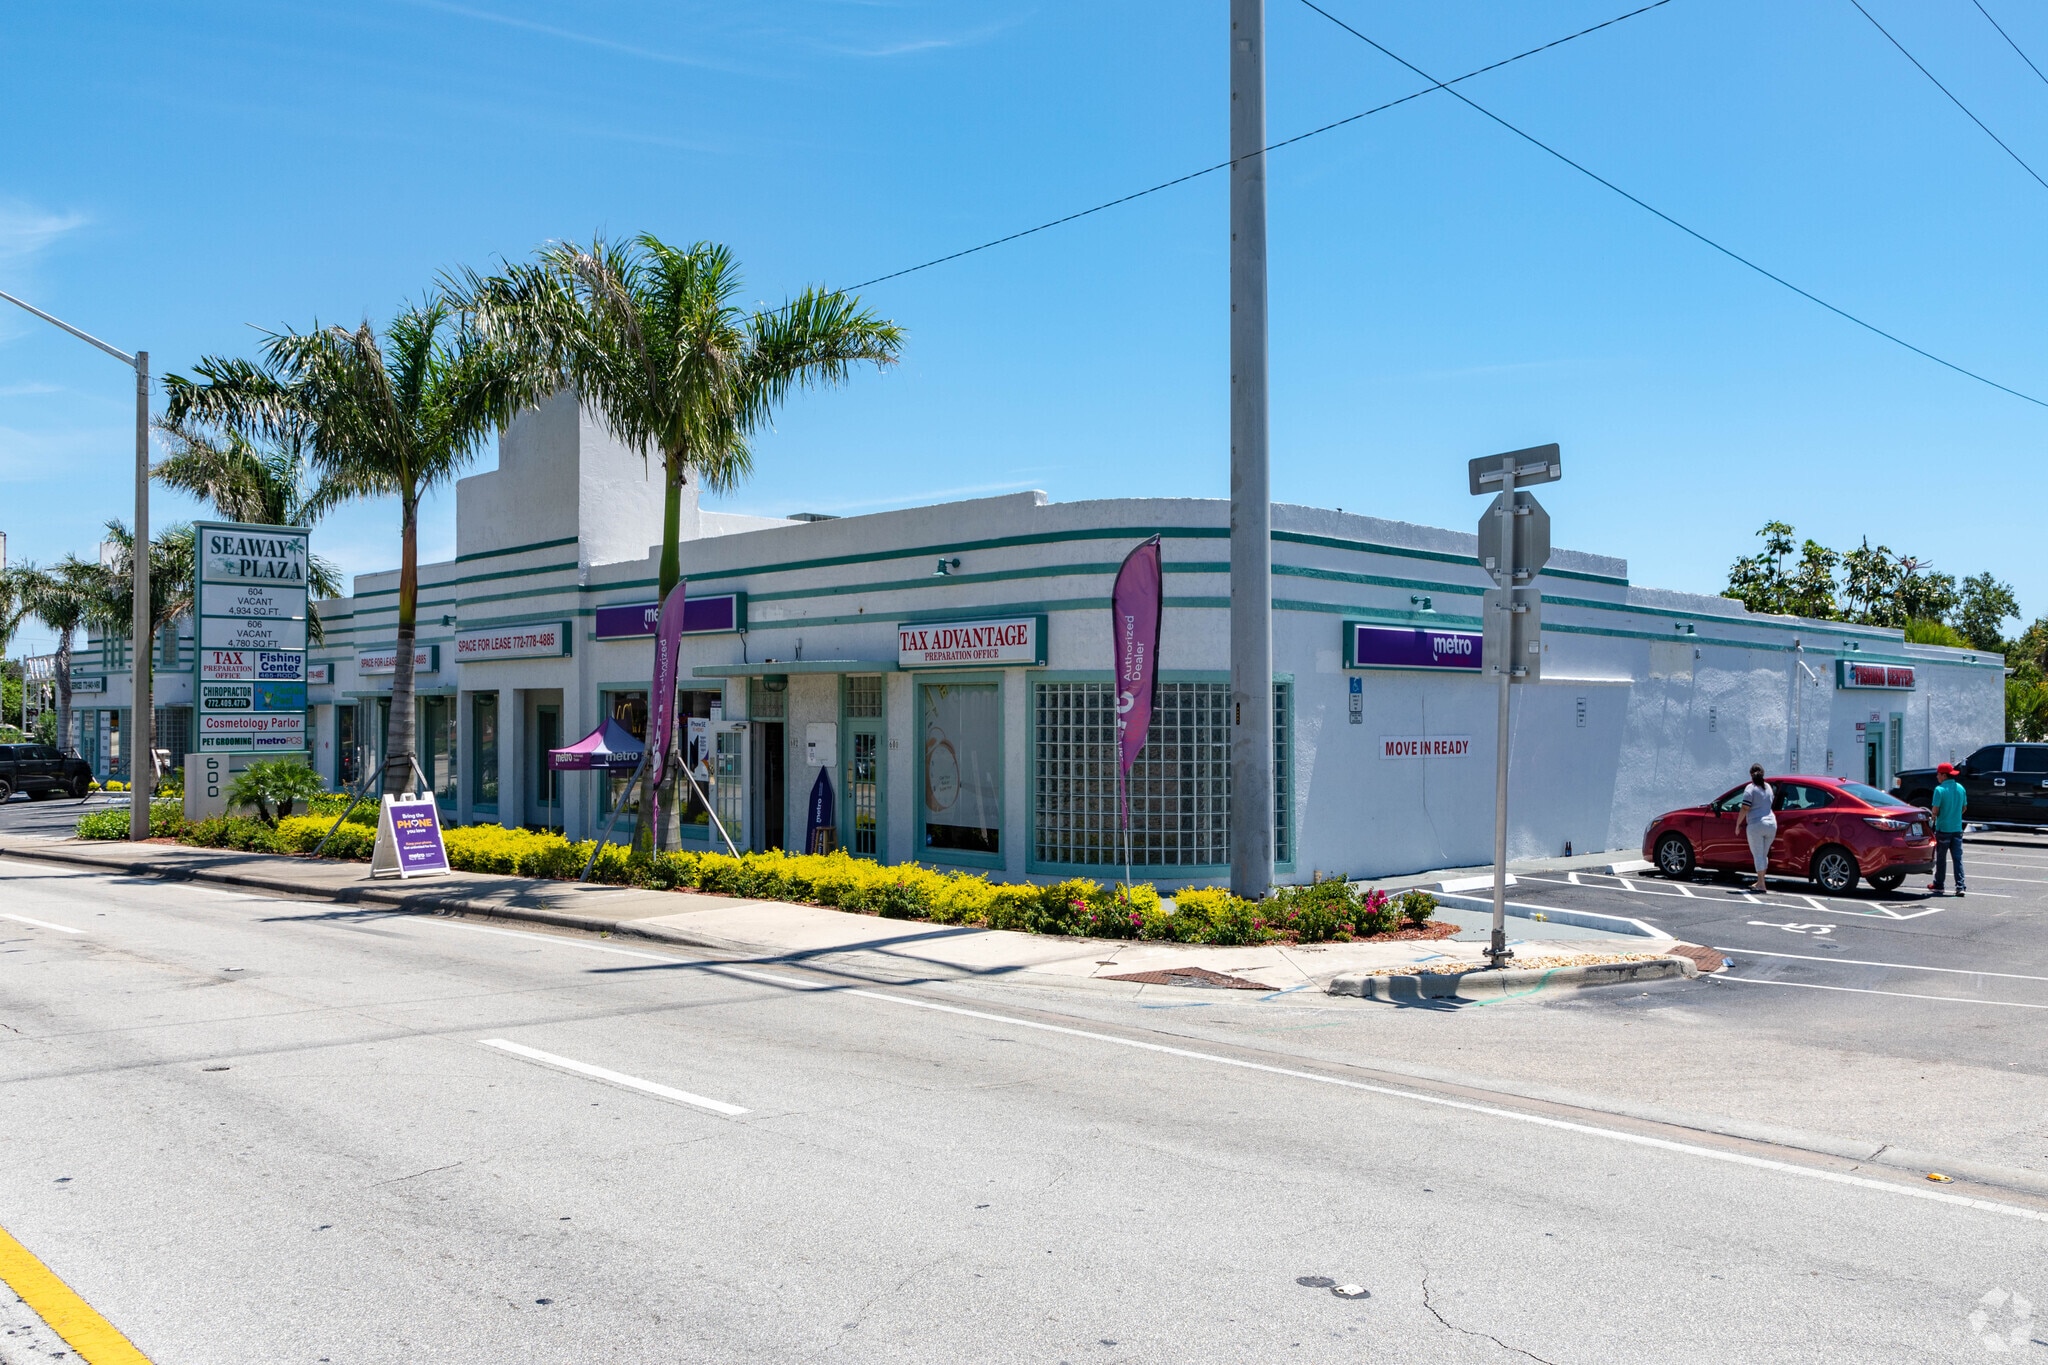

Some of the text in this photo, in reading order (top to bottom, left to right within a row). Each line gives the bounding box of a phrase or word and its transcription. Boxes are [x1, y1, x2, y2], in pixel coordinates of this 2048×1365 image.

[211, 535, 289, 558] SEAWAY
[239, 558, 302, 580] PLAZA
[247, 588, 263, 596] 604
[237, 597, 273, 606] VACANT
[228, 606, 251, 615] 4,934
[247, 620, 263, 628] 606
[236, 629, 273, 638] VACANT
[900, 624, 1027, 651] TAX ADVANTAGE
[227, 639, 250, 648] 4,780
[458, 633, 555, 653] SPACE FOR LEASE 772-778-4885
[1123, 615, 1135, 682] Authorized
[1433, 635, 1472, 656] metro
[213, 651, 243, 665] TAX
[259, 652, 301, 665] Fishing
[924, 648, 999, 661] PREPARATION OFFICE
[1132, 641, 1145, 681] Dealer
[261, 662, 300, 672] Center
[361, 657, 374, 668] SPACE
[374, 657, 383, 667] FOR
[1855, 665, 1914, 687] FISHING CENTER
[203, 686, 252, 697] CHIROPRACTOR
[206, 717, 300, 730] Cosmetology Parlor
[202, 737, 252, 746] PET GROOMING
[256, 736, 302, 745] metroPCS
[1385, 740, 1469, 756] MOVE IN READY
[556, 751, 573, 764] metro
[605, 751, 638, 762] metro
